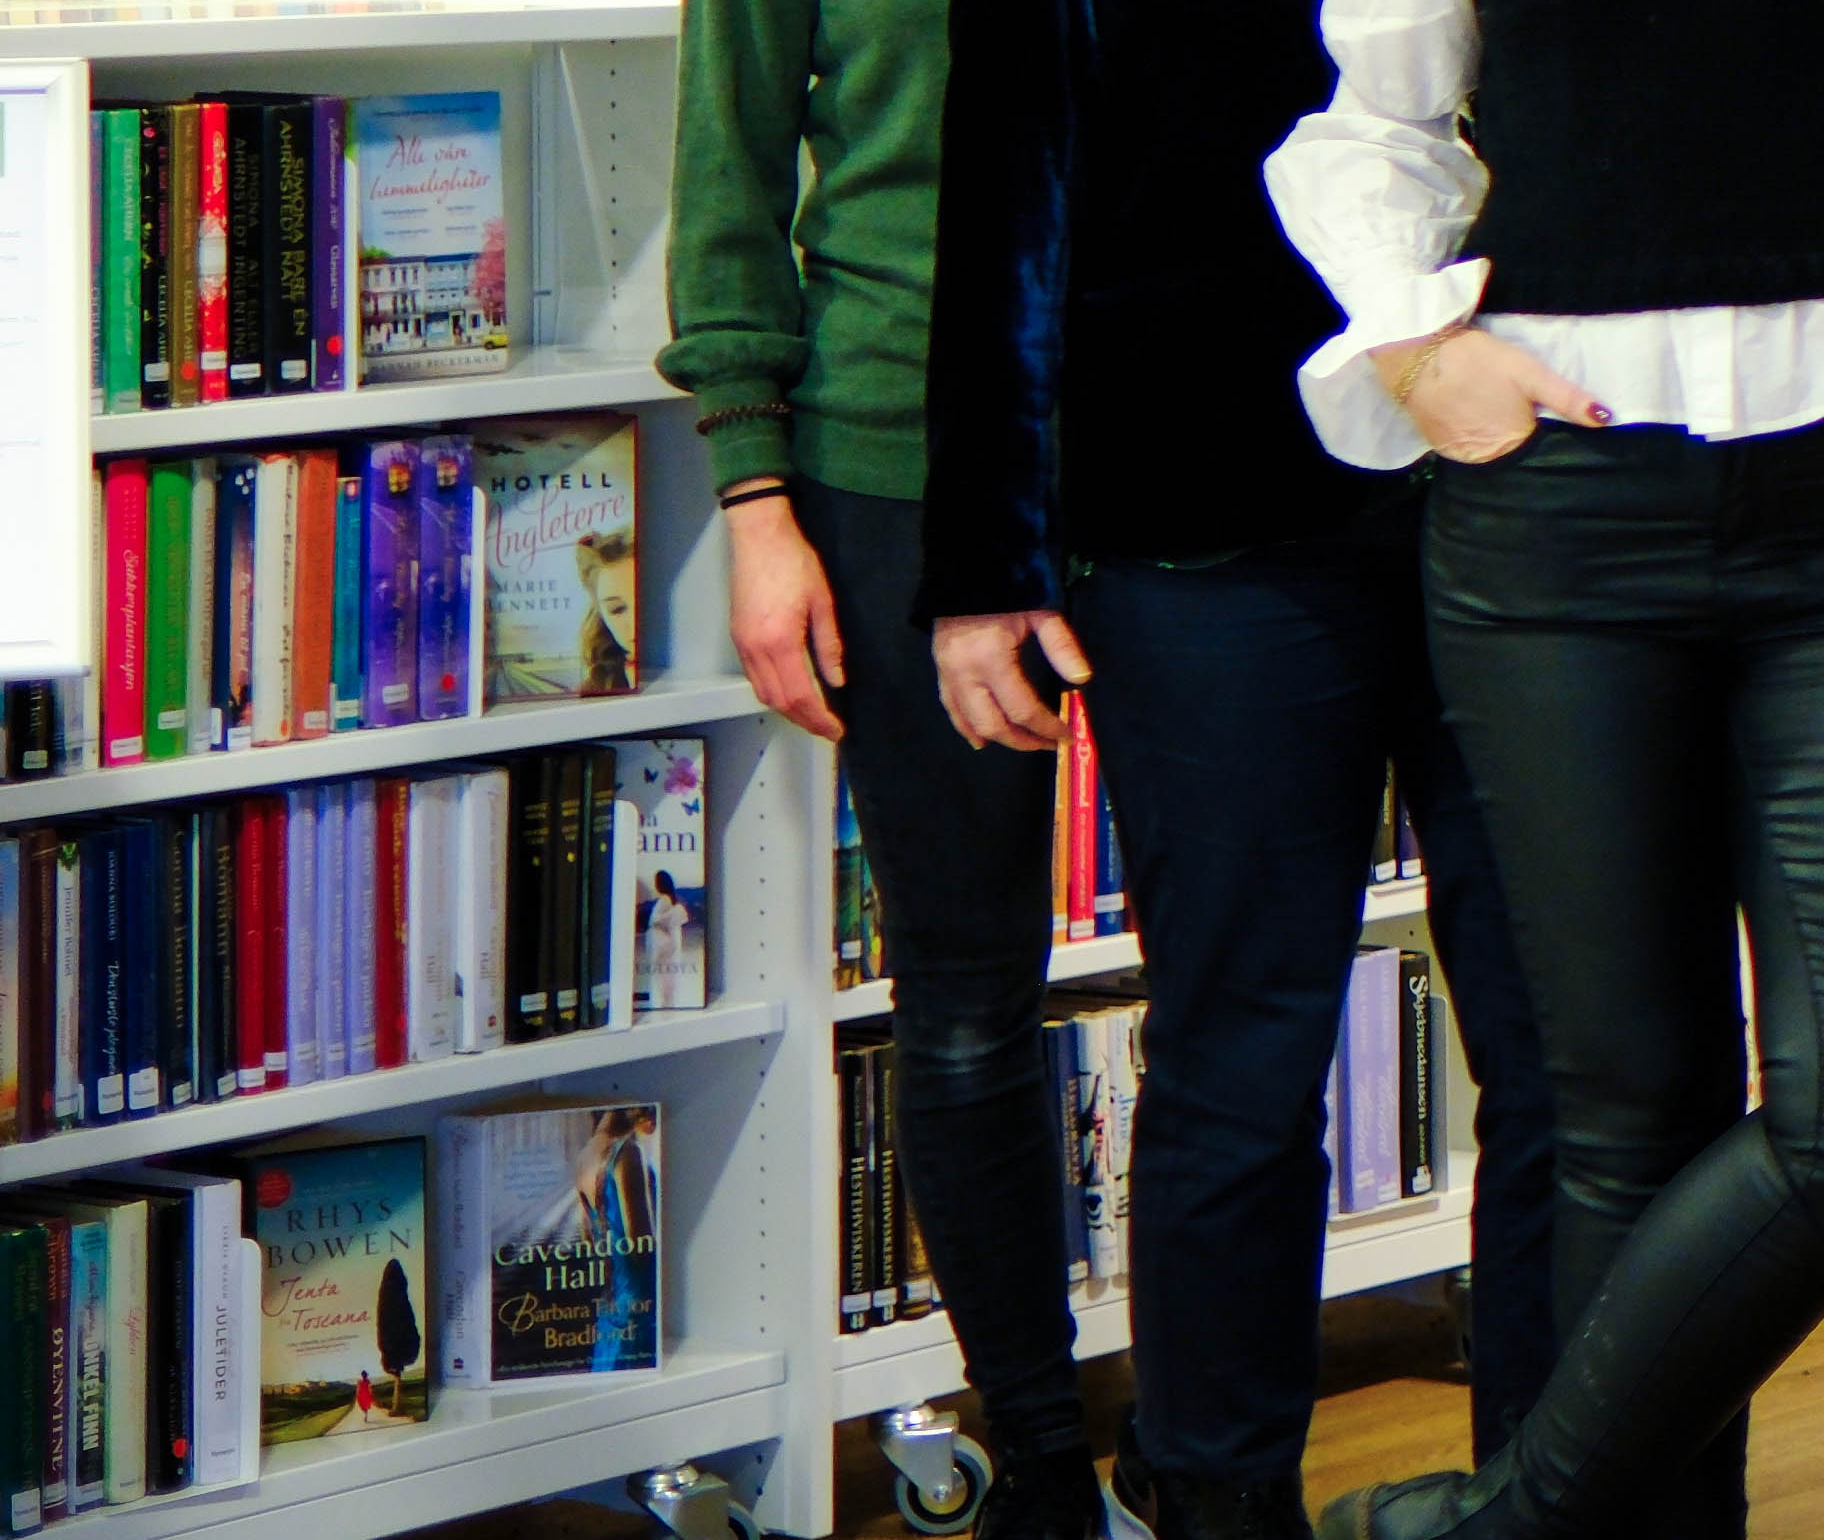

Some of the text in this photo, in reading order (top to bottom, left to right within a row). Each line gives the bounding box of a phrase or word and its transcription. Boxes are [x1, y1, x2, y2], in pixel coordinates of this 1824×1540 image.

[491, 473, 612, 492] HOTELL
[495, 579, 558, 594] MARIE
[286, 1196, 394, 1233] RHYS
[267, 1226, 413, 1269] BOWEN
[494, 1229, 654, 1266] Cavendon
[545, 1260, 606, 1291] Hall
[262, 1276, 341, 1318] Jenta
[498, 1292, 591, 1336] Barbara
[292, 1307, 371, 1332] Toscana
[214, 1305, 229, 1402] JULETIDER
[82, 1403, 101, 1452] FINN
